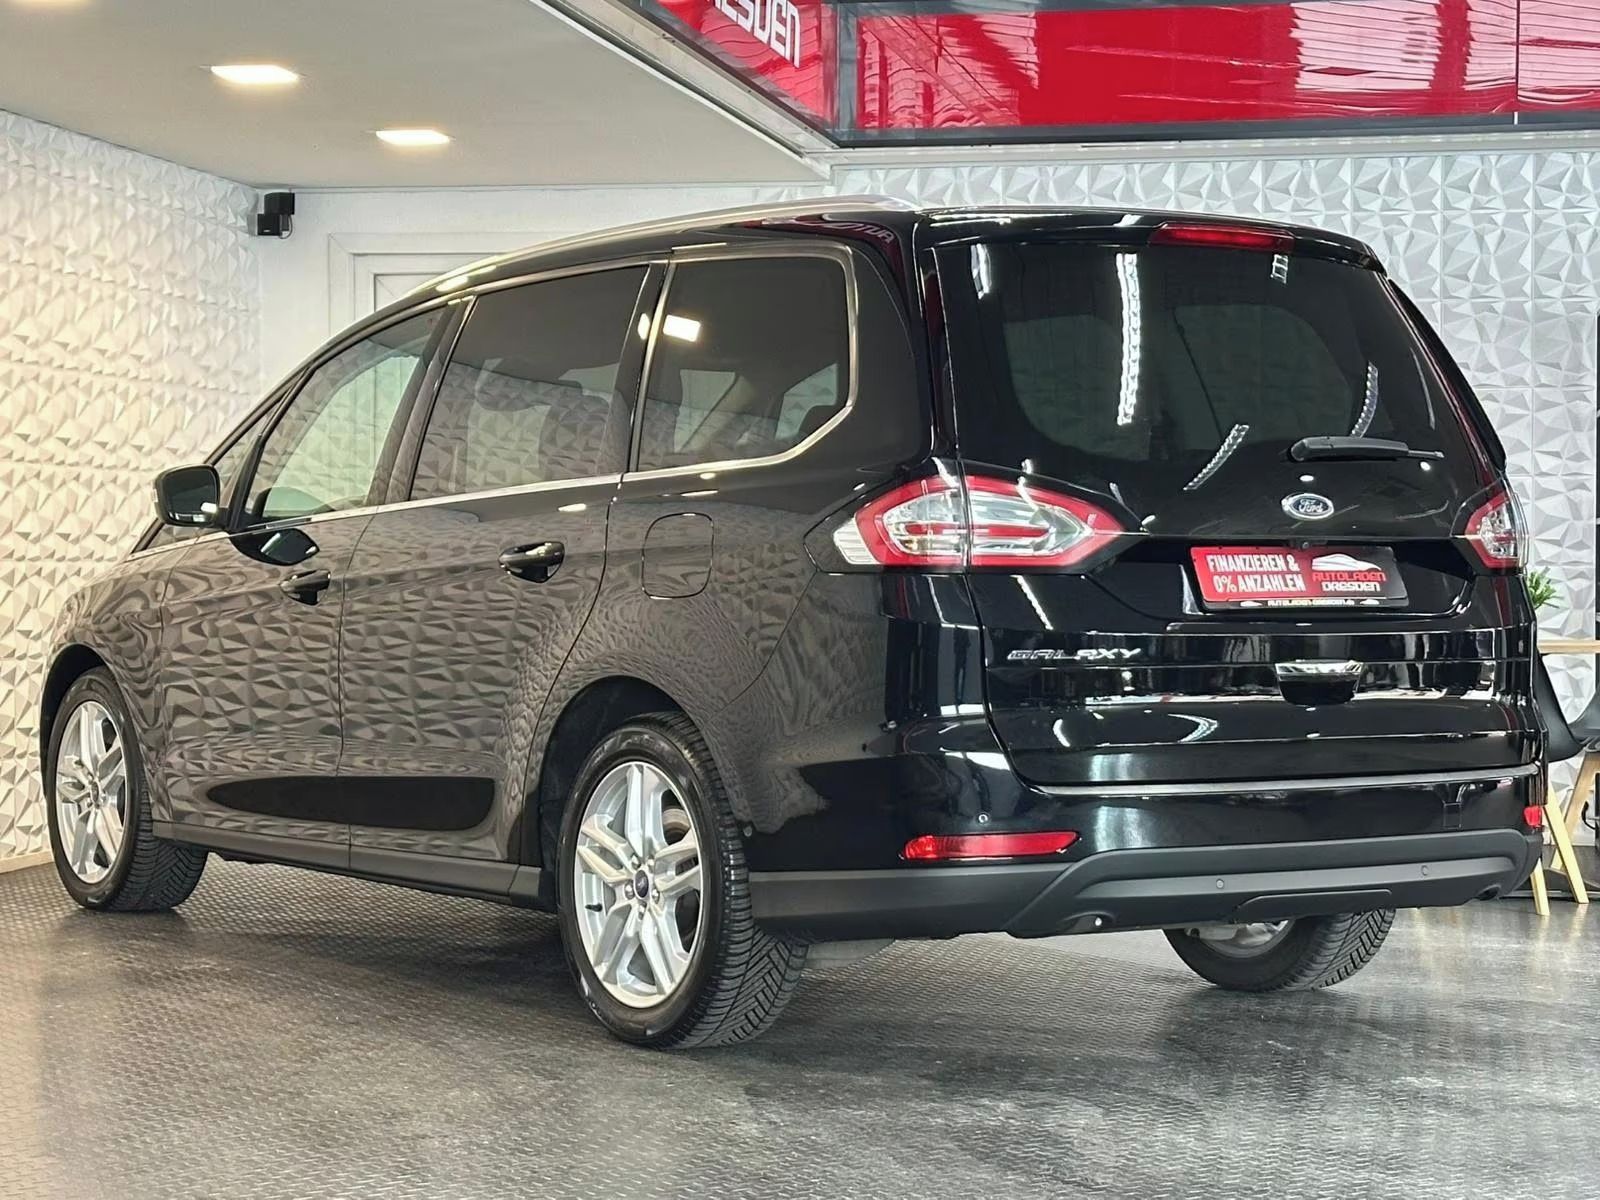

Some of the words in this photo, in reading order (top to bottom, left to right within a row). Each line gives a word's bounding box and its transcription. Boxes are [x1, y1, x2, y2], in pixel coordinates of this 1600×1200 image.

[1205, 554, 1288, 572] FINANZIEREN
[1286, 554, 1301, 572] &
[1212, 574, 1238, 593] 0%
[1236, 573, 1307, 593] ANZAHLEN
[1312, 572, 1387, 582] AUTOLADEN
[1321, 581, 1381, 592] DRESDEN
[1007, 648, 1141, 661] GALAXY
